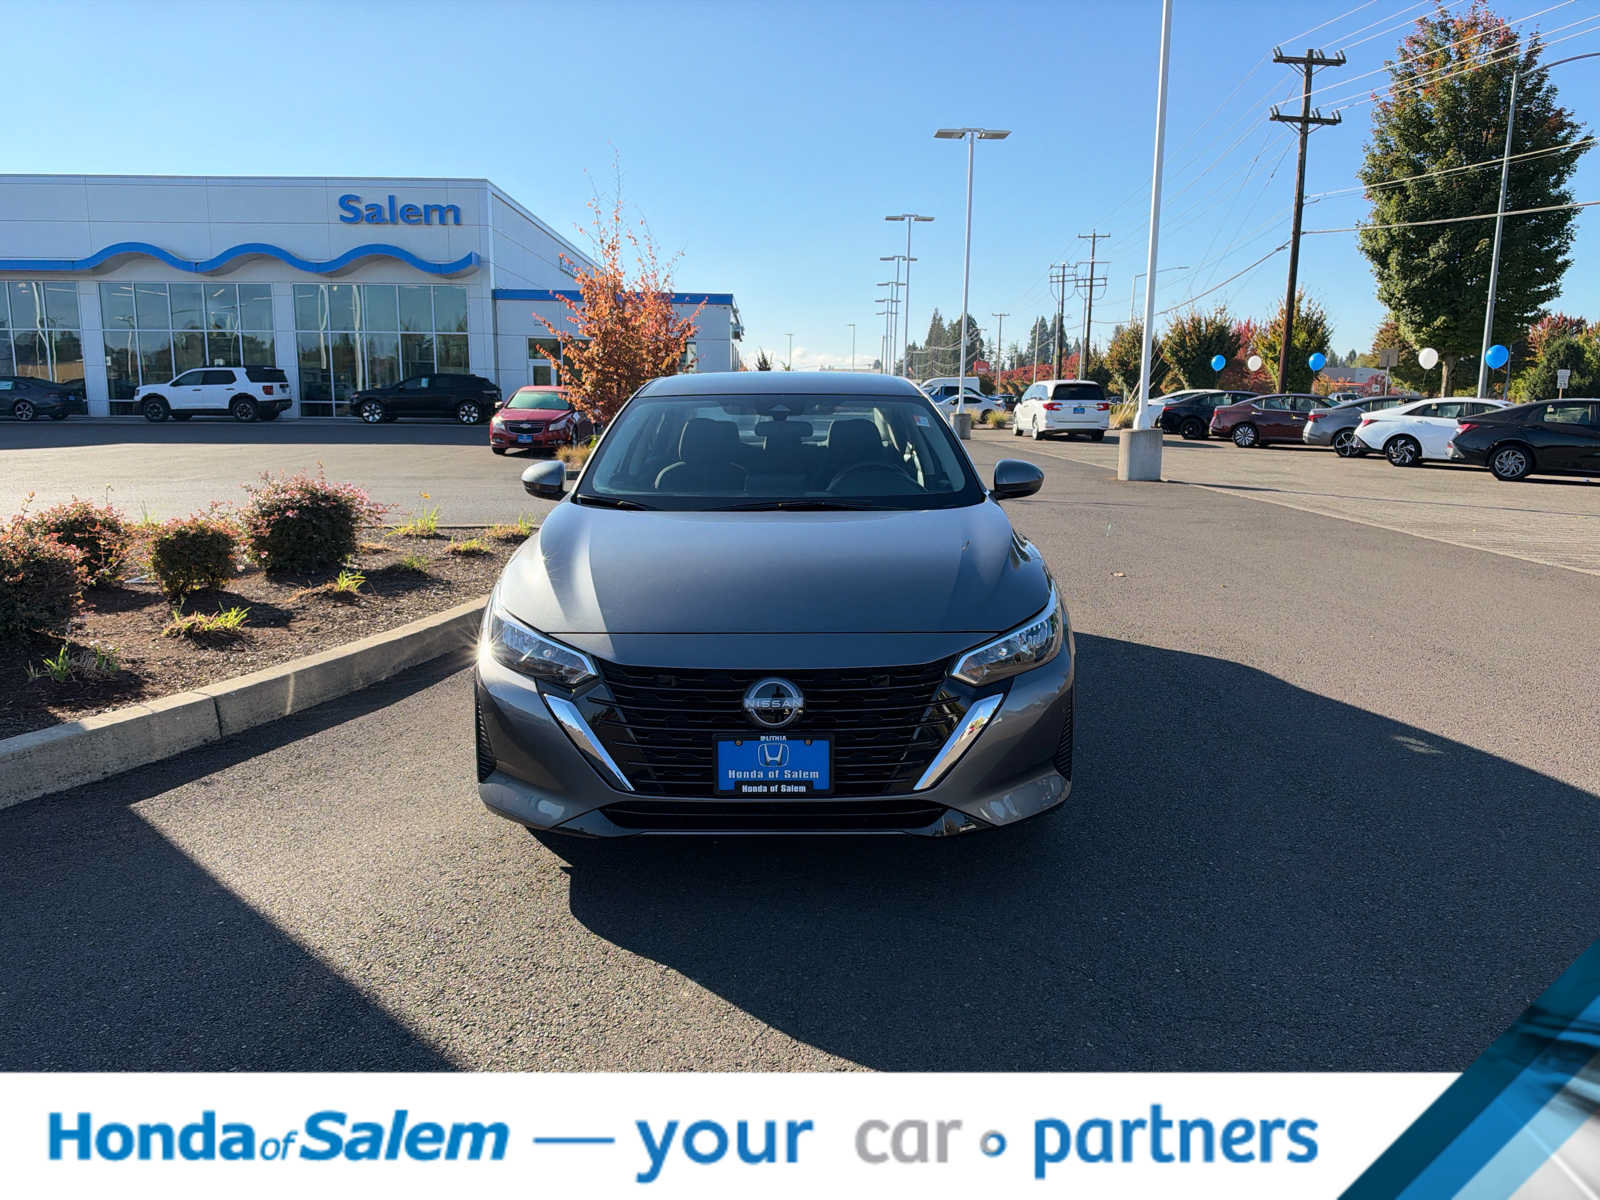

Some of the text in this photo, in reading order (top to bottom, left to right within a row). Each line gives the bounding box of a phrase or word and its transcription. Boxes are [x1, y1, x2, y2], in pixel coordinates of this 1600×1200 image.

[338, 193, 462, 225] Salem
[744, 698, 803, 709] NISSAN
[728, 769, 819, 779] Honda of Salem
[742, 784, 806, 793] Honda of Salem
